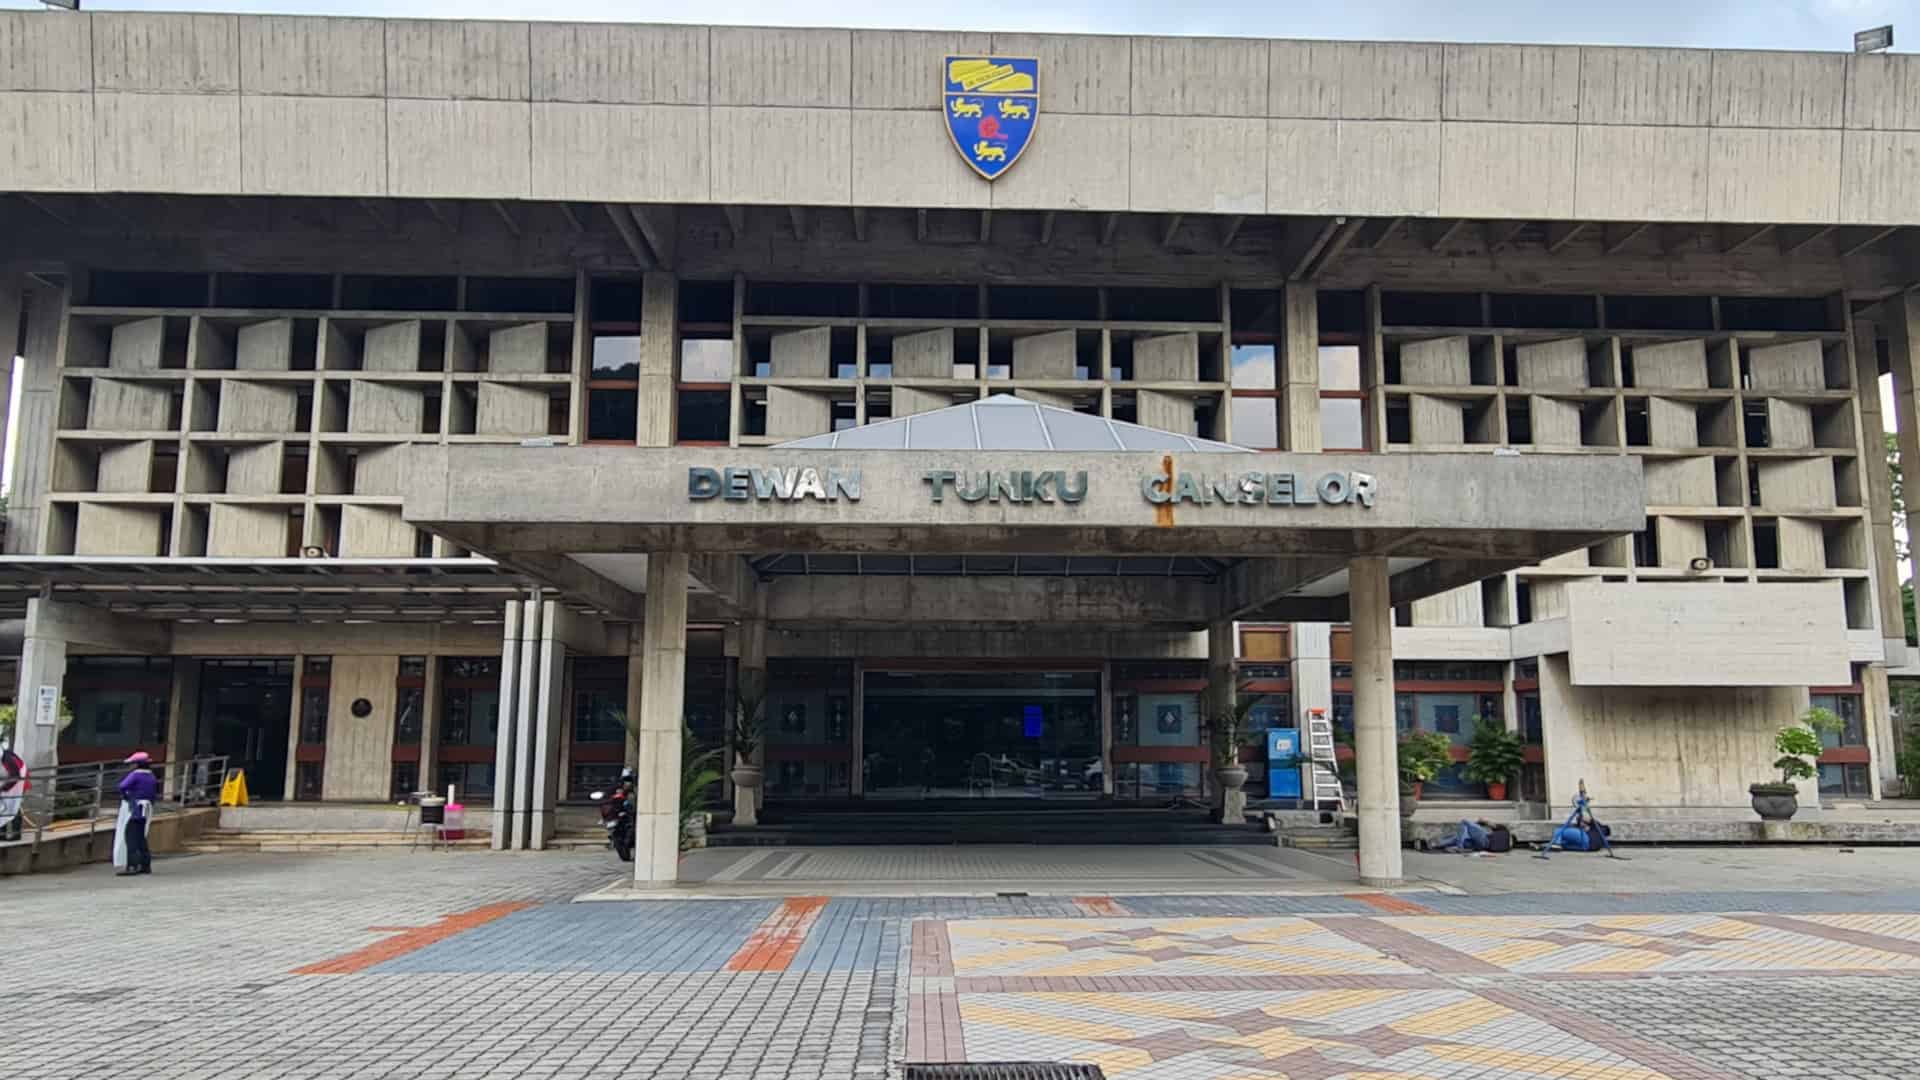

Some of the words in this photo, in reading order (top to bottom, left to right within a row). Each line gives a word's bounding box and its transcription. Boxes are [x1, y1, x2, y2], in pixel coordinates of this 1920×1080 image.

[688, 467, 861, 502] DEWAN
[923, 470, 1088, 504] TUNKU
[1142, 471, 1377, 507] CANSELOR
